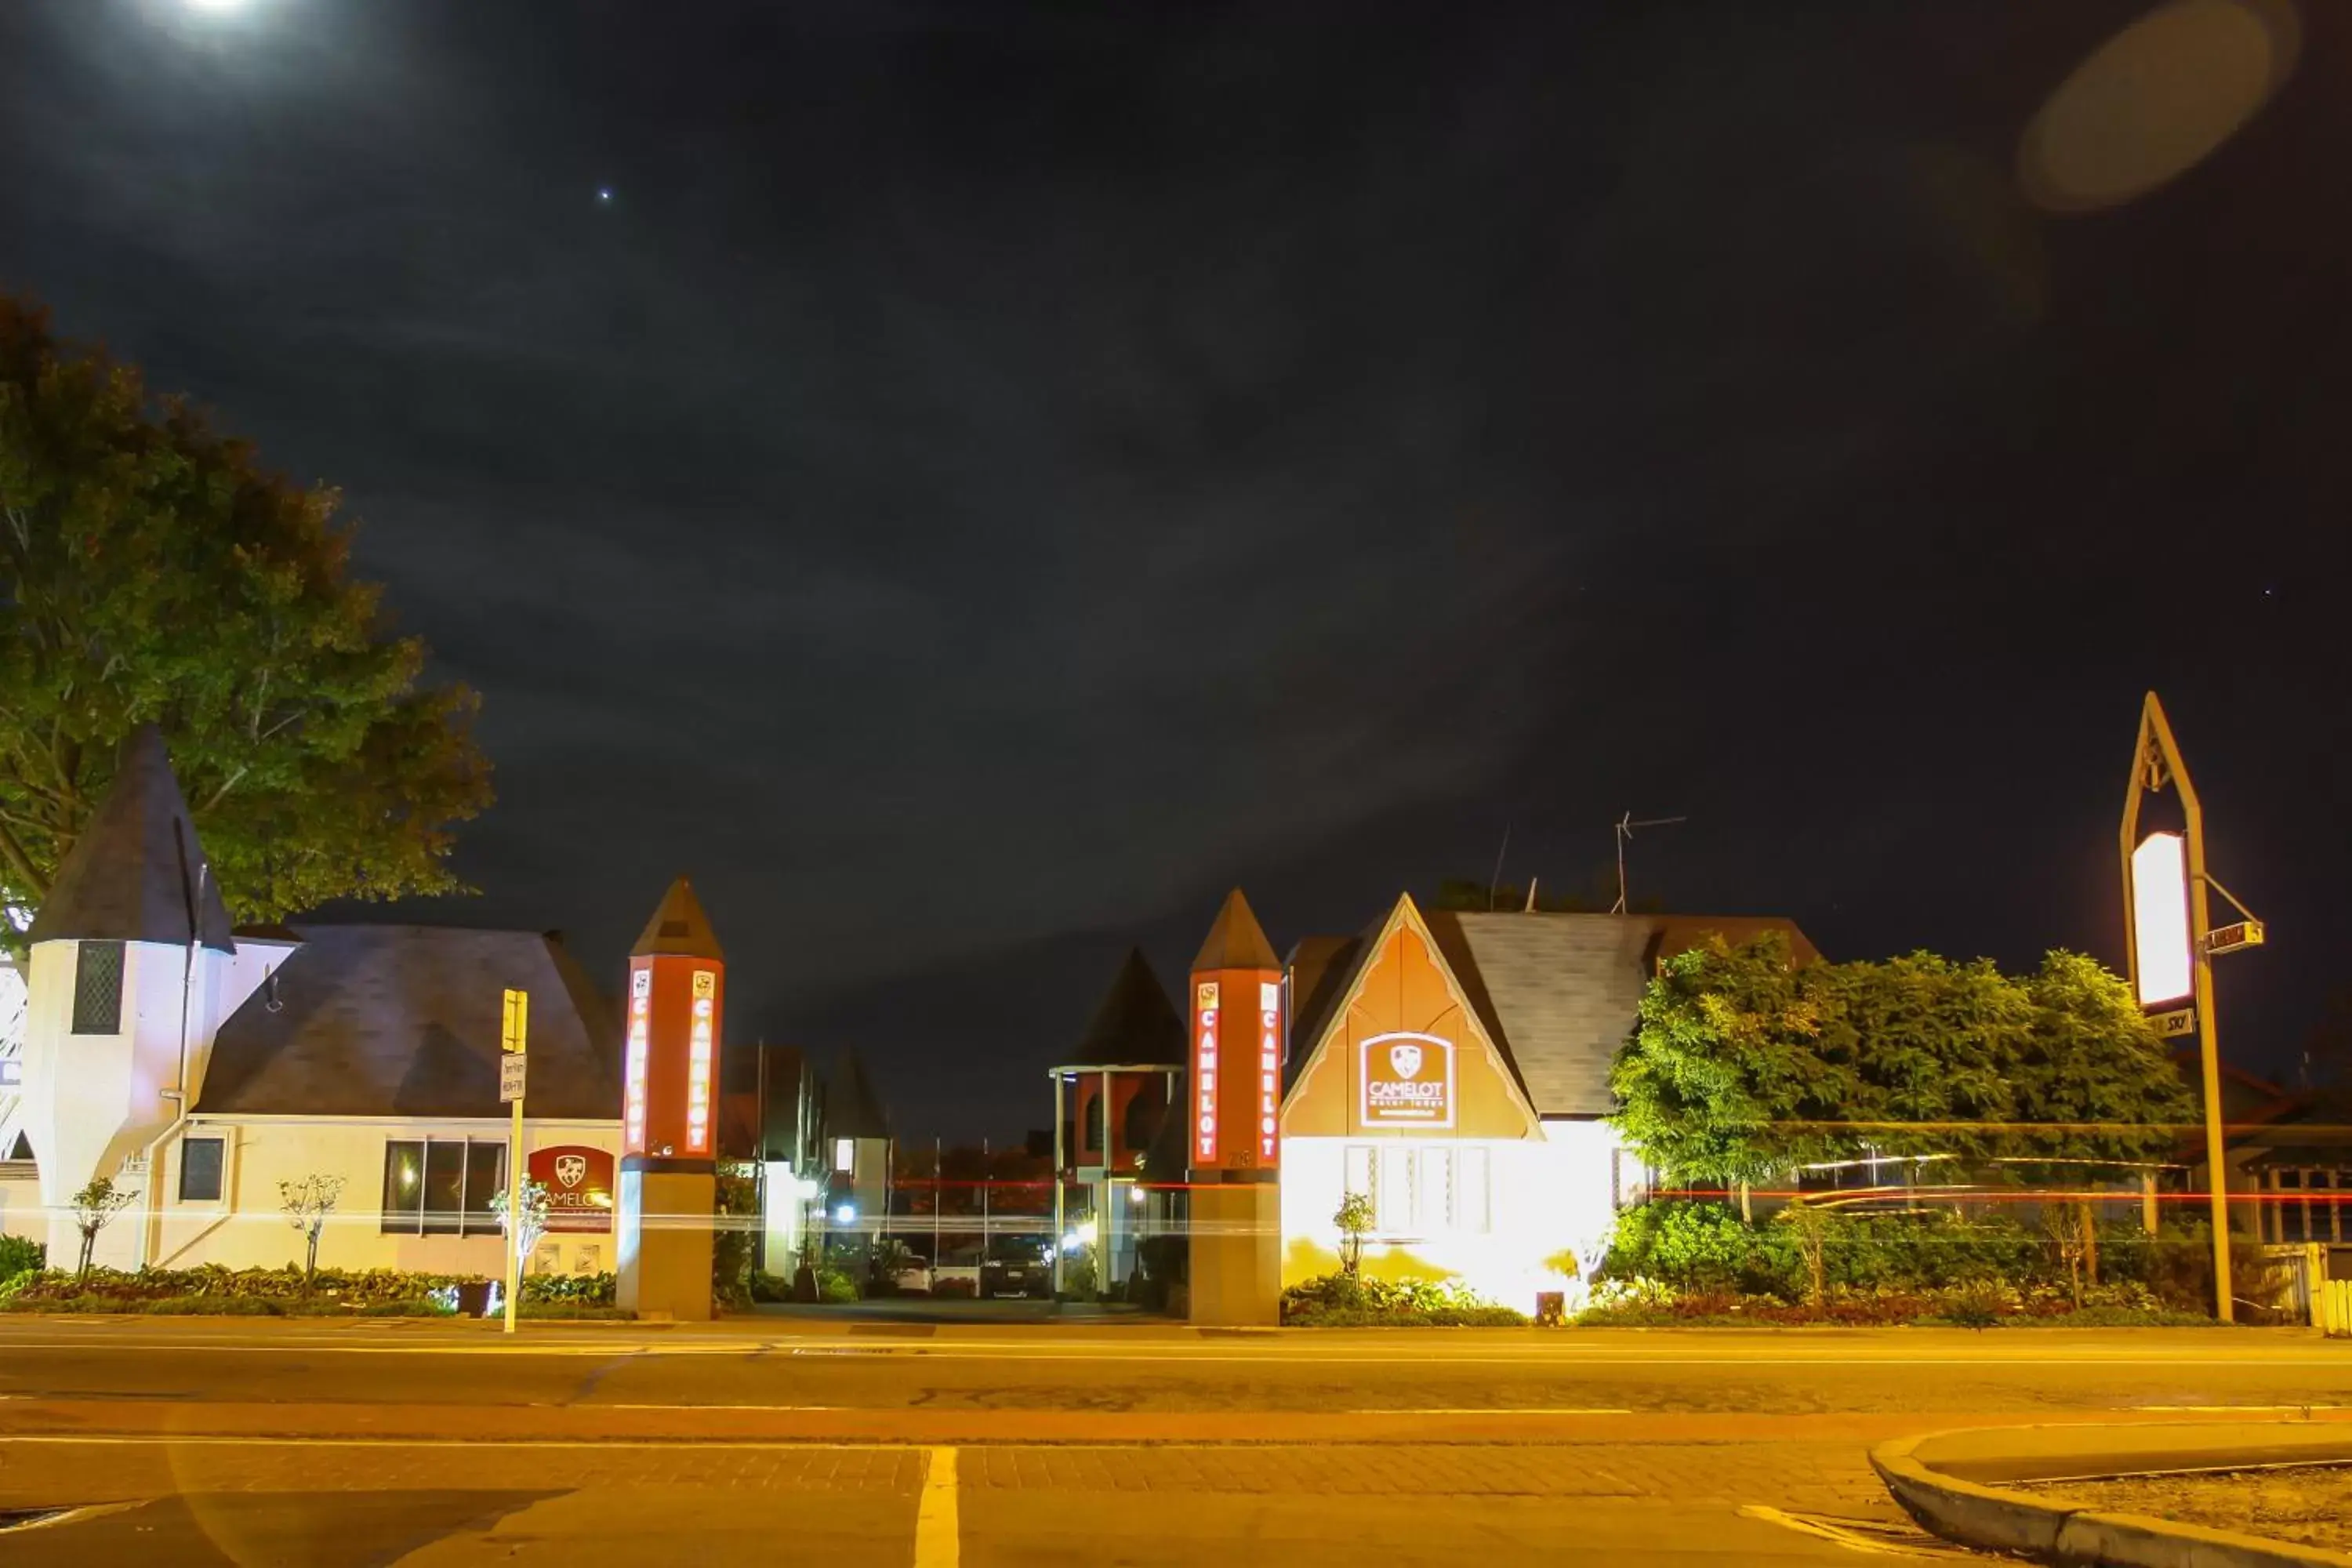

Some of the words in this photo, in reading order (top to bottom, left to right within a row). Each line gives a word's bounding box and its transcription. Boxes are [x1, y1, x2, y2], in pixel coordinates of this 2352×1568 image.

[1200, 1011, 1217, 1155] CAMELOT
[1261, 1011, 1276, 1156] CAMELOT
[1369, 1081, 1443, 1097] CAMELOT
[536, 1192, 607, 1207] AMELO
